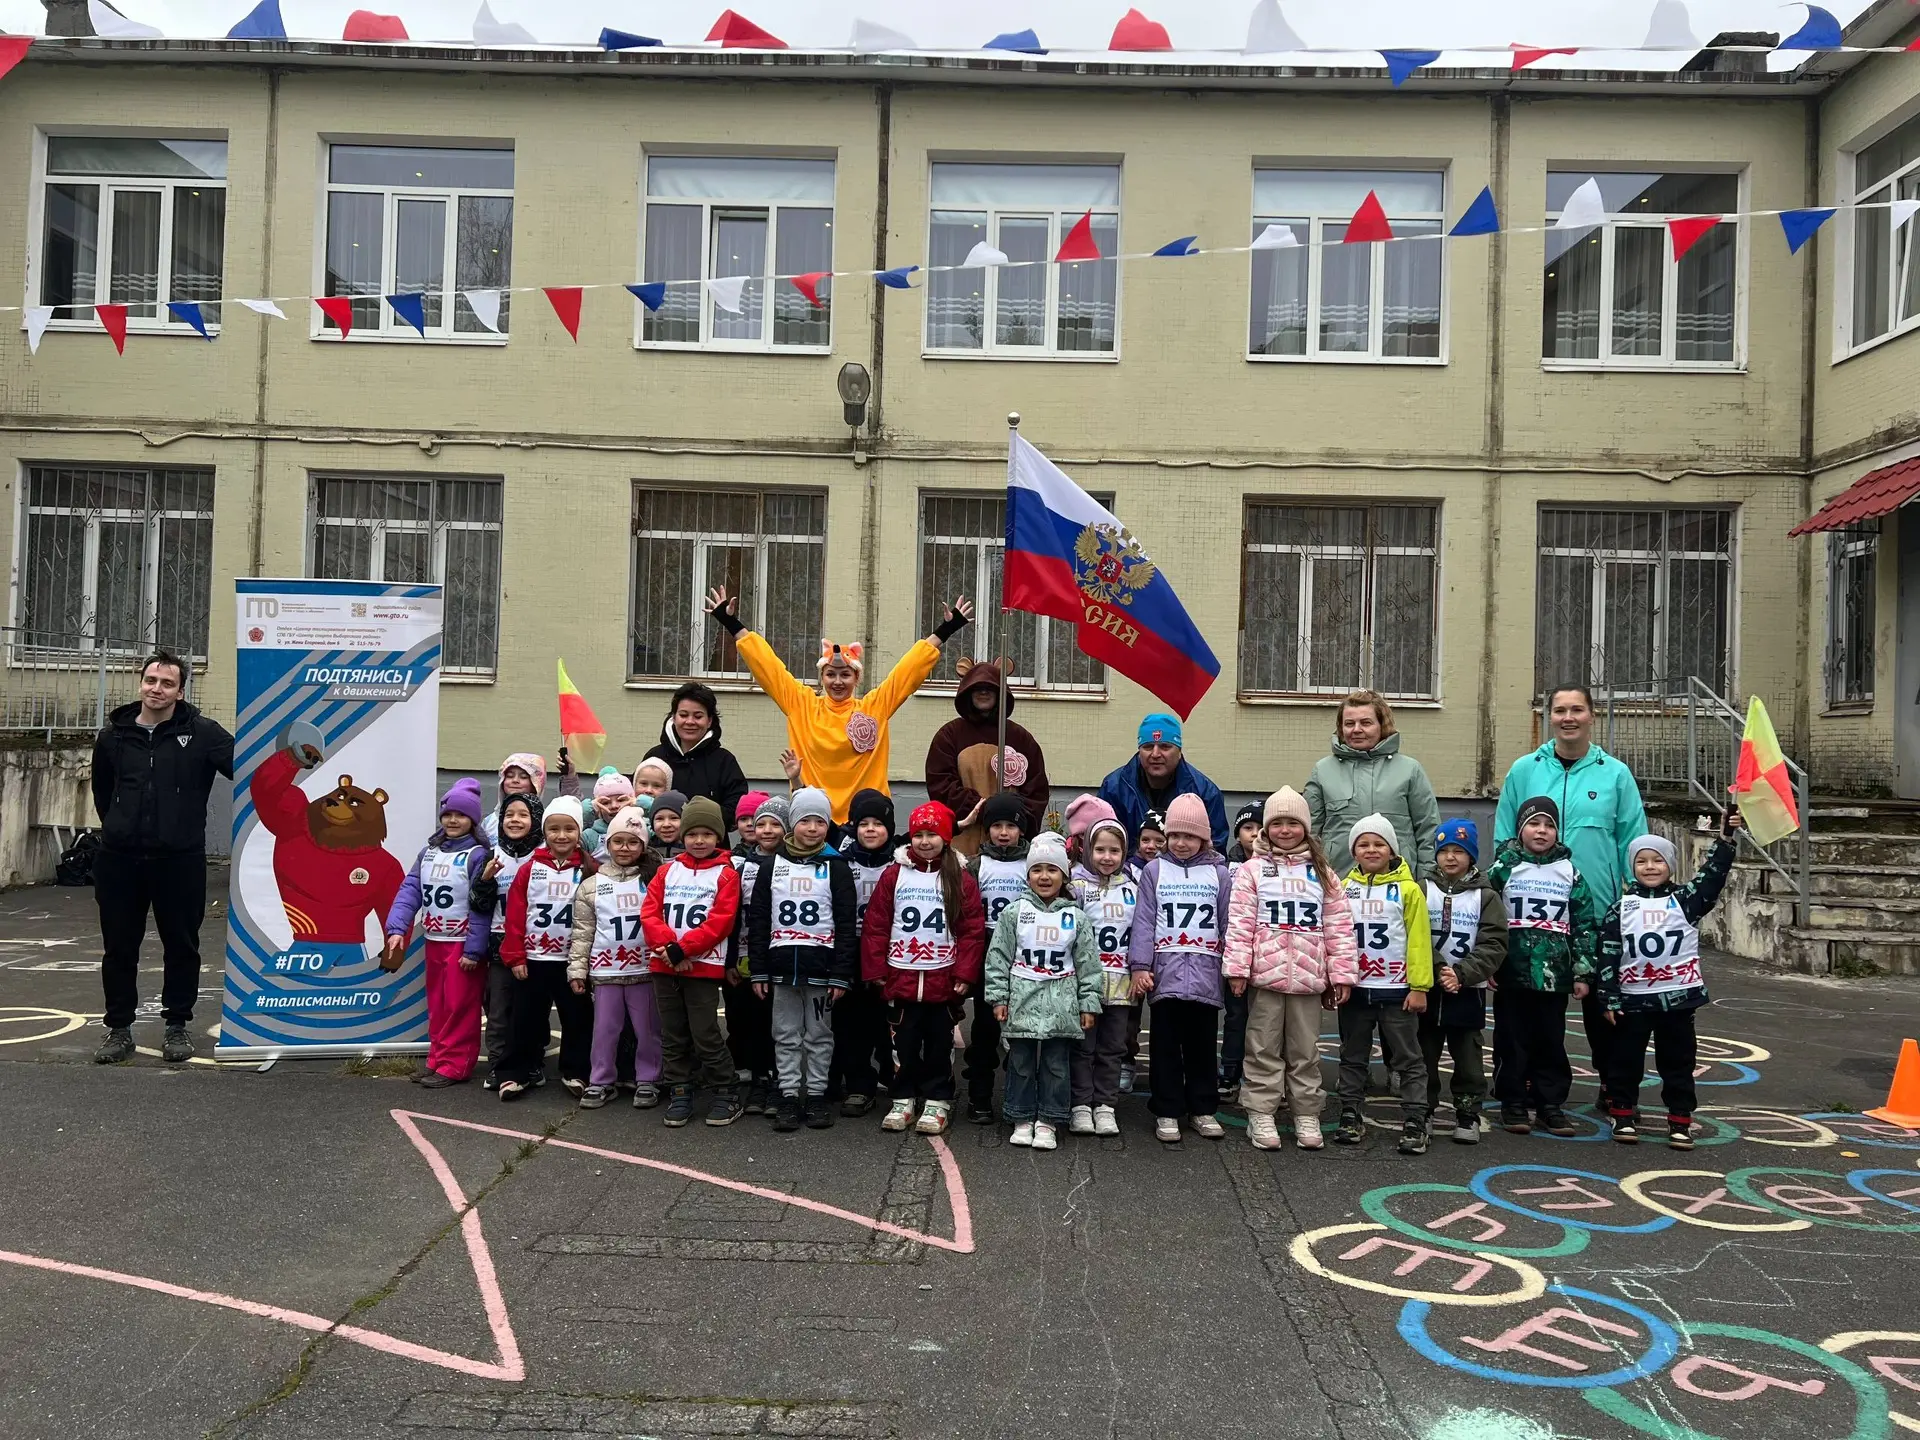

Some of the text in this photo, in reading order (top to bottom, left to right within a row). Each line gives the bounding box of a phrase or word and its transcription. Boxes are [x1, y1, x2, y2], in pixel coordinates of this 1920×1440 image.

[246, 598, 278, 618] ГТО
[1084, 604, 1140, 649] СИЯ
[333, 687, 341, 697] к
[431, 864, 450, 878] ГТО
[422, 884, 454, 909] 36
[549, 881, 571, 896] ГТО
[790, 877, 812, 892] ГТО
[1282, 878, 1306, 893] ГТО
[616, 892, 640, 908] ГТО
[1103, 902, 1124, 918] ГТО
[1361, 899, 1384, 915] ГТО
[1509, 896, 1567, 922] 137
[533, 903, 573, 928] 34
[663, 902, 708, 929] 116
[778, 900, 820, 926] 88
[901, 906, 945, 934] 94
[1161, 902, 1215, 929] 172
[1266, 900, 1318, 927] 113
[609, 914, 642, 941] 17
[1036, 925, 1060, 941] ГТО
[1092, 925, 1132, 952] 64
[1353, 922, 1390, 950] 13
[1431, 929, 1471, 958] 73
[1624, 930, 1684, 959] 107
[275, 954, 323, 971] #ГТО
[1021, 948, 1066, 973] 115
[256, 991, 381, 1008] #талисманыГТО
